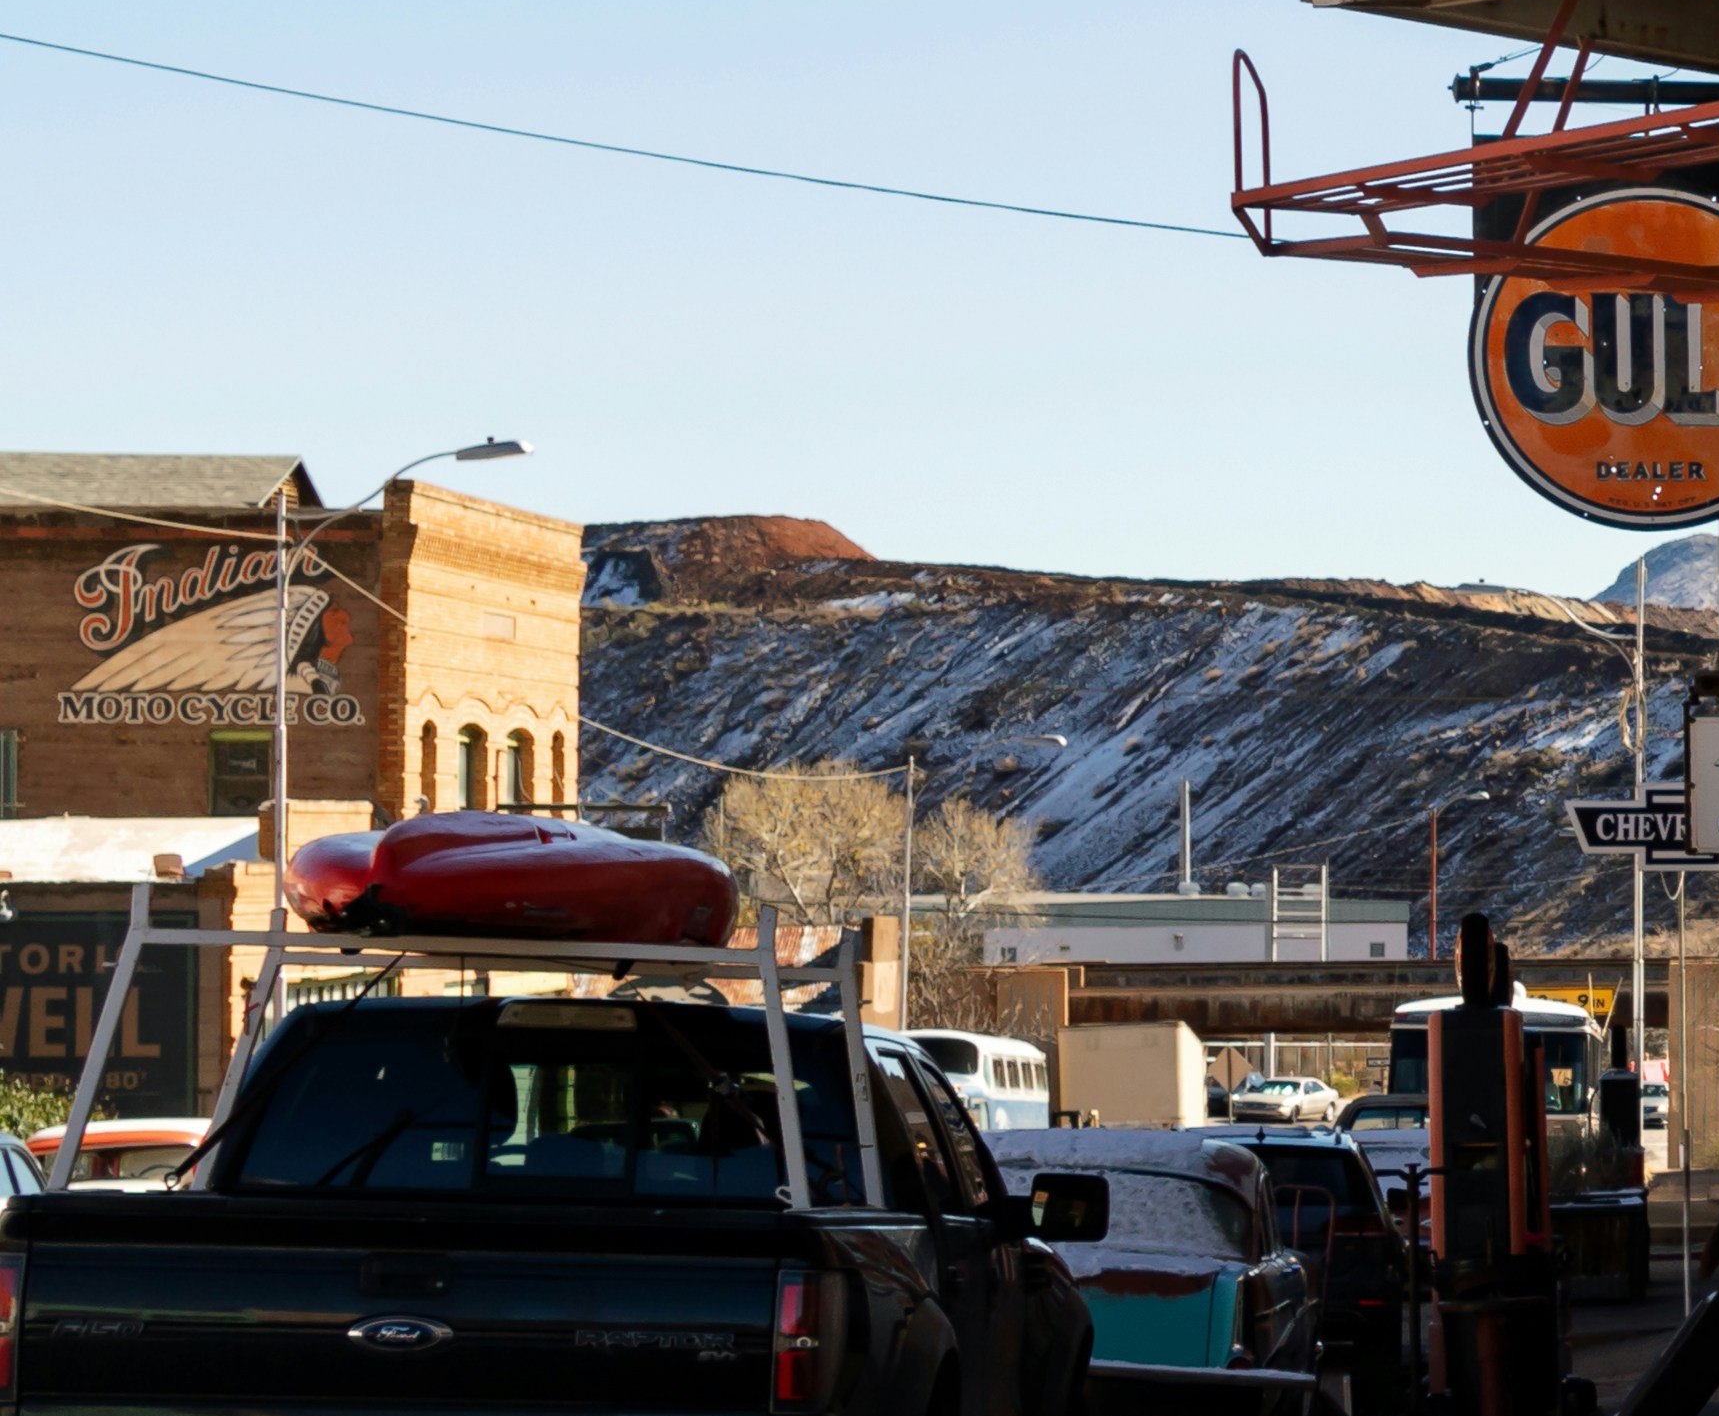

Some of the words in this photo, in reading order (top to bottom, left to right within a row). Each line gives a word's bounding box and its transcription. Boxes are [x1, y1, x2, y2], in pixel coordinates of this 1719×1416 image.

[1596, 461, 1707, 480] DEALER
[74, 543, 328, 651] Indian
[304, 693, 366, 726] CO.
